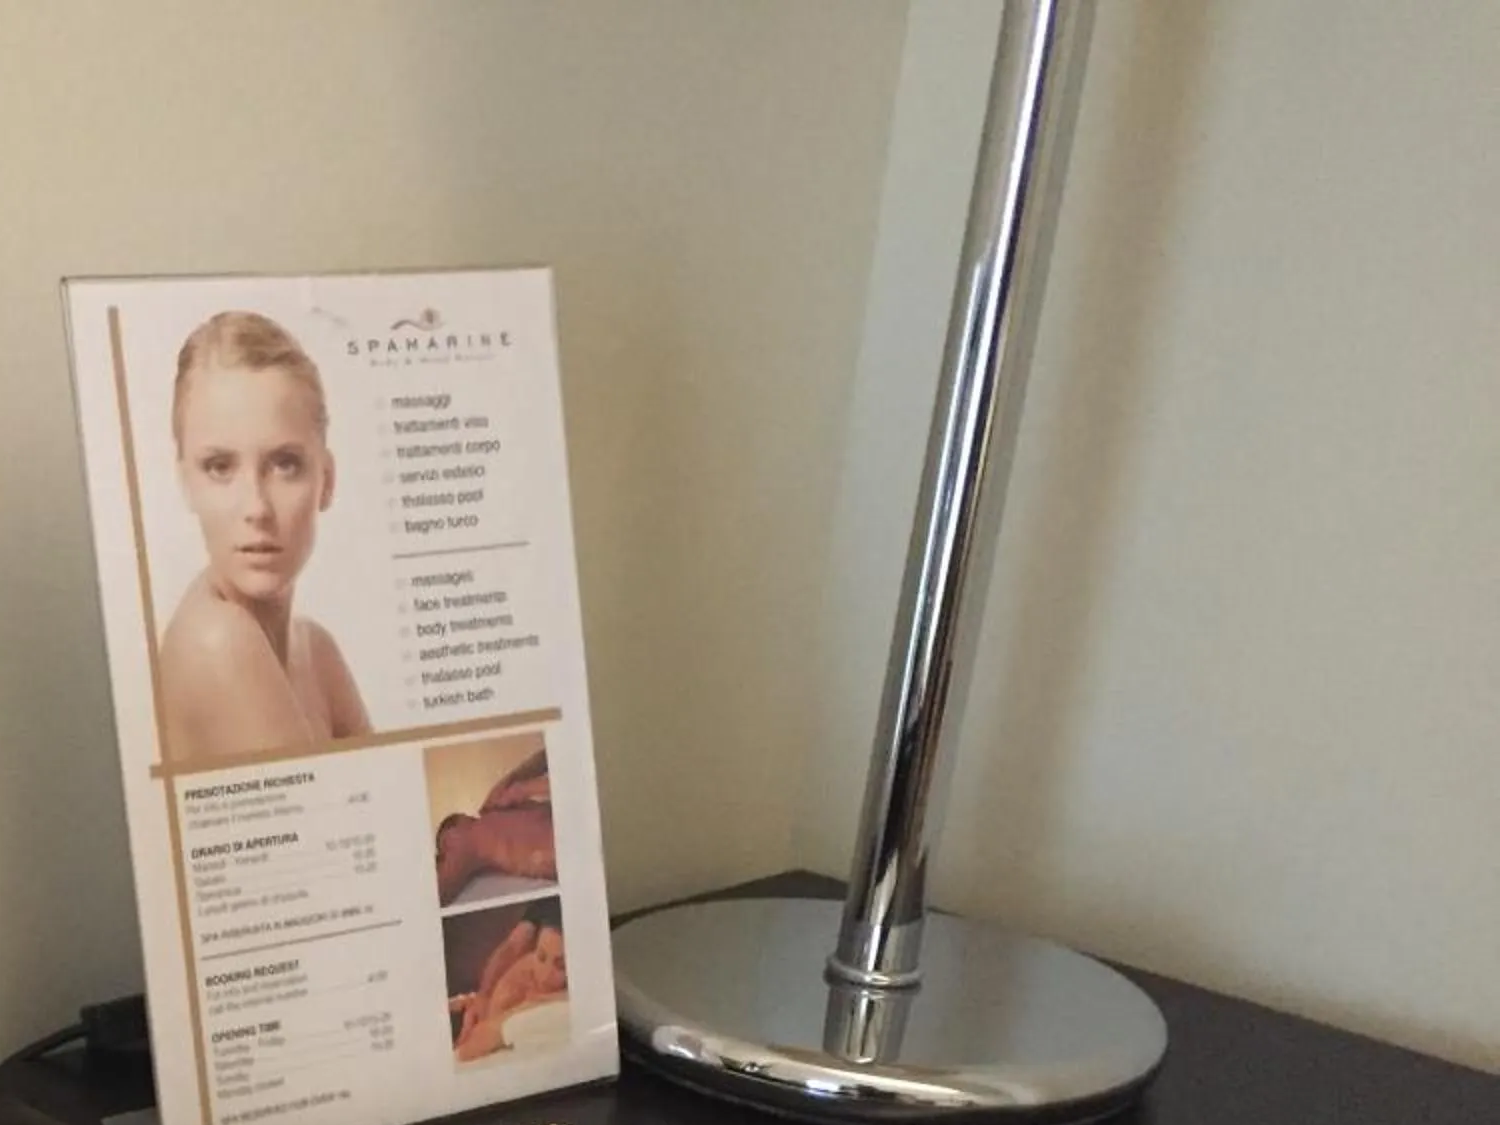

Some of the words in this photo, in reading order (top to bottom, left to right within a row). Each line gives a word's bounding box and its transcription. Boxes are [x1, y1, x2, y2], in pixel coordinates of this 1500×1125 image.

[346, 332, 512, 356] SPAMARINE
[465, 440, 501, 454] corpo
[457, 488, 484, 505] pool
[404, 518, 445, 535] bagno
[416, 622, 447, 638] body
[475, 661, 502, 680] pool
